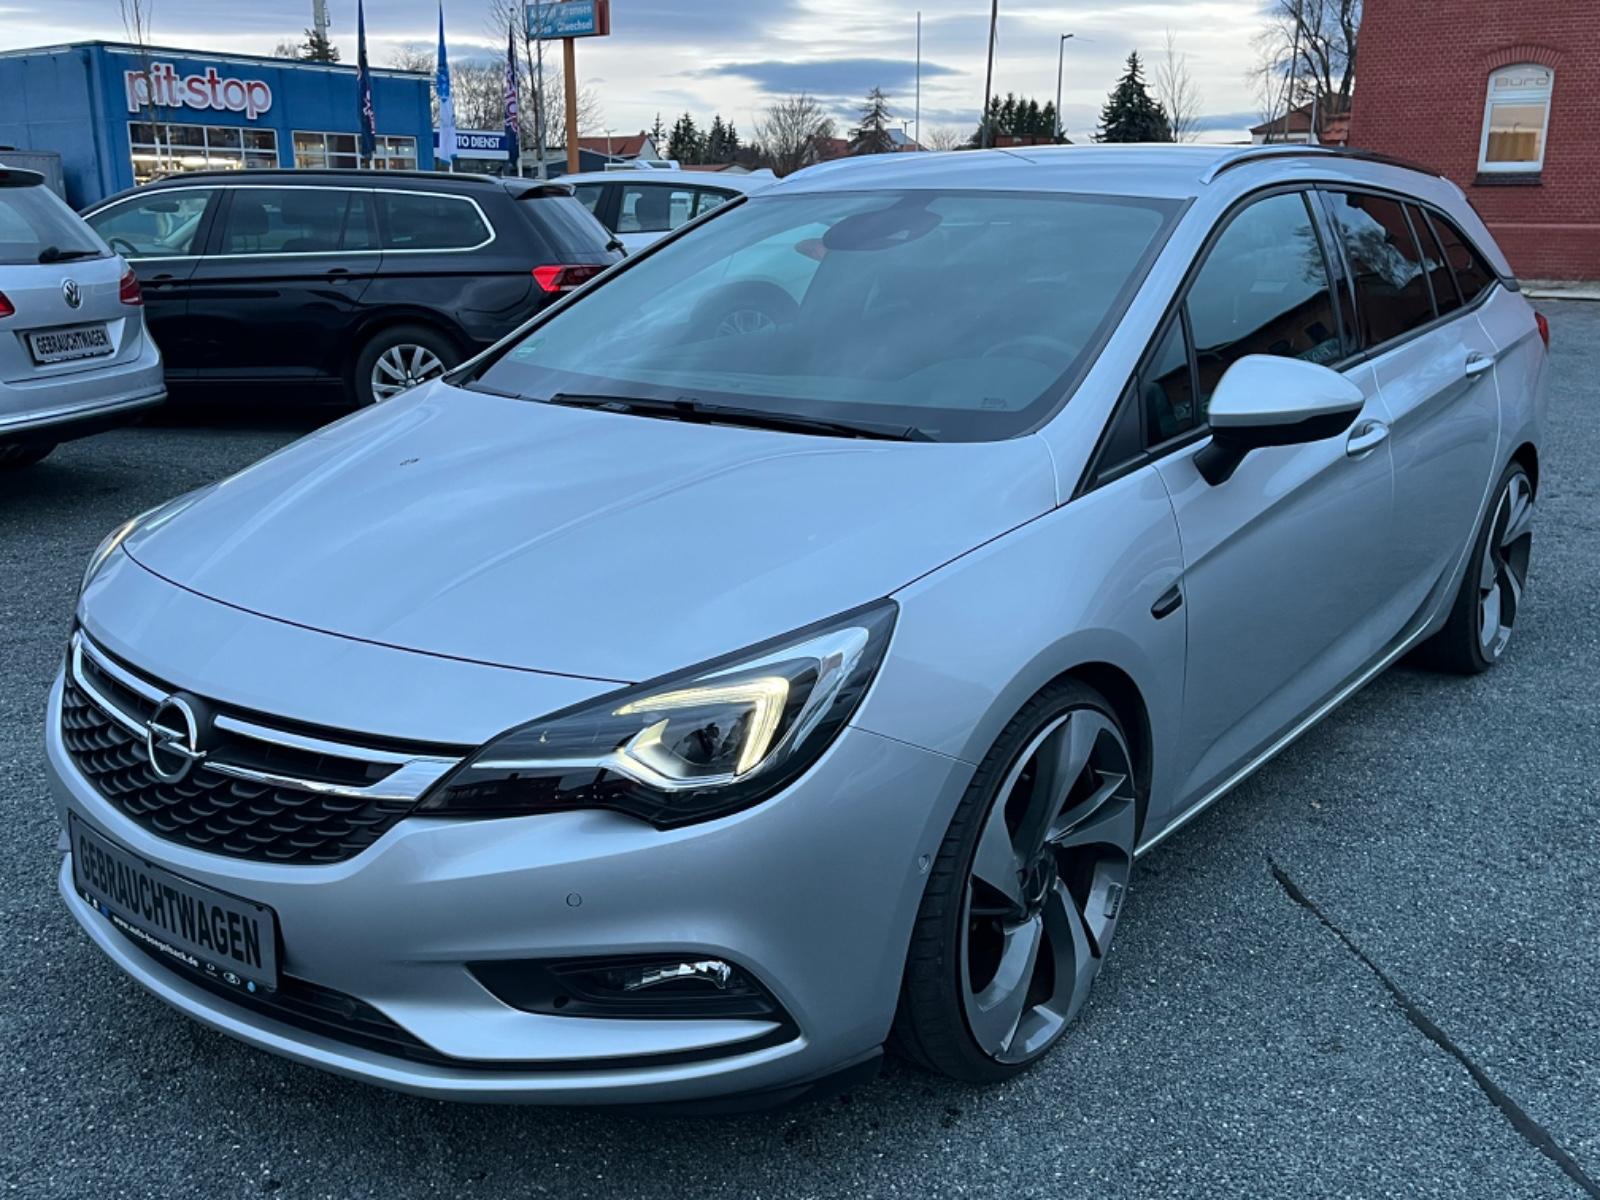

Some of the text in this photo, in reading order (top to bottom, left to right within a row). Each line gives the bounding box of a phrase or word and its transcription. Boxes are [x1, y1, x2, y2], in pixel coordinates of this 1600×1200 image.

[470, 135, 500, 149] DIENST
[35, 329, 109, 354] GEBRAUCHTWAGEN
[80, 834, 262, 970] GEBRAUCHTWAGEN
